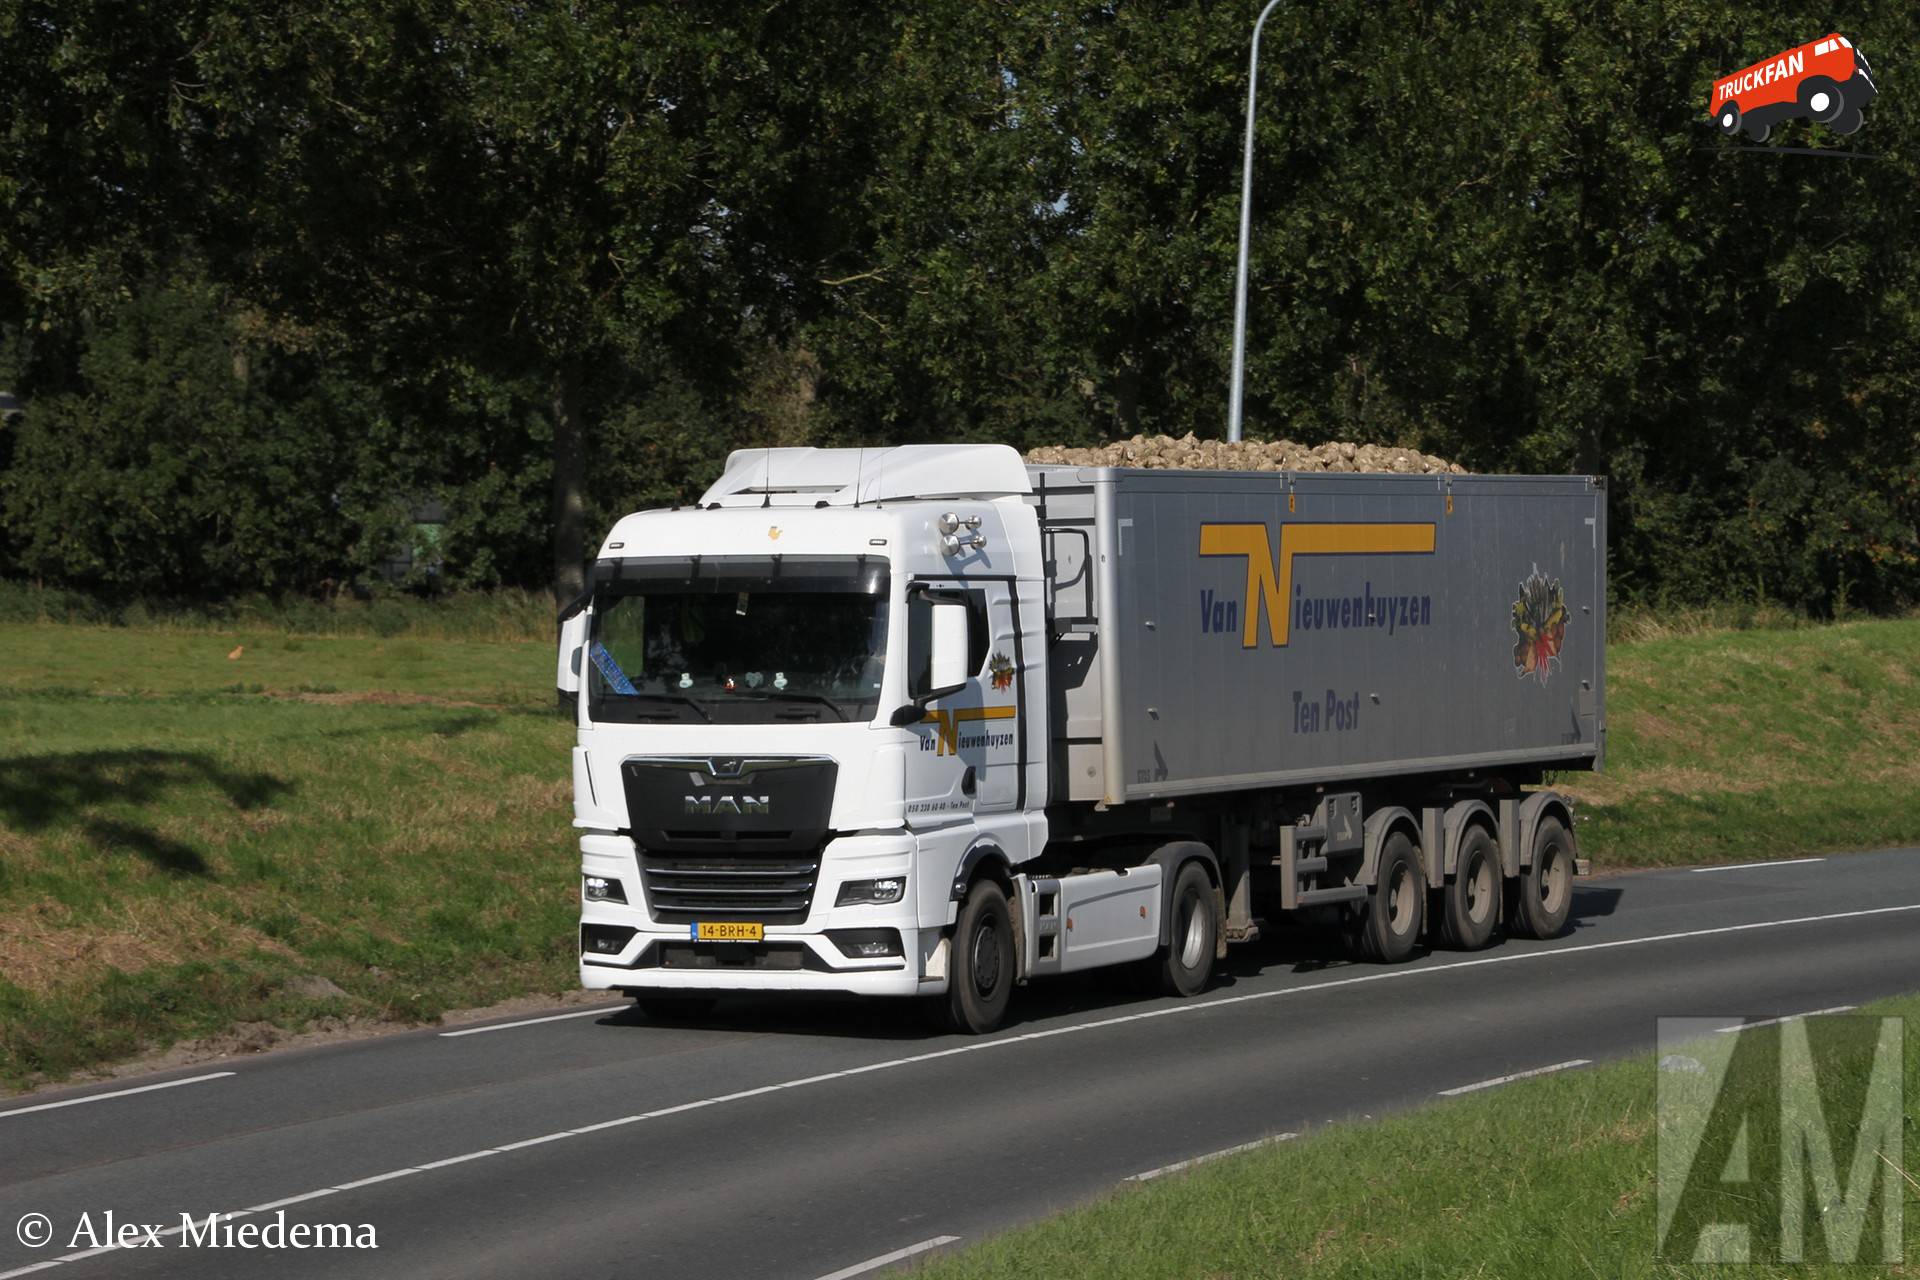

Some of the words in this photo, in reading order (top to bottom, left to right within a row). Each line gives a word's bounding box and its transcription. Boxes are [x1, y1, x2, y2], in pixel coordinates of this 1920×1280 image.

[1200, 589, 1238, 634] Van
[1241, 522, 1432, 650] Nieuwenhuyzen
[1293, 690, 1320, 734] Ten
[1325, 689, 1360, 732] Post
[920, 735, 936, 752] Van
[684, 795, 769, 815] MAN
[702, 924, 757, 937] 14-BRH-4
